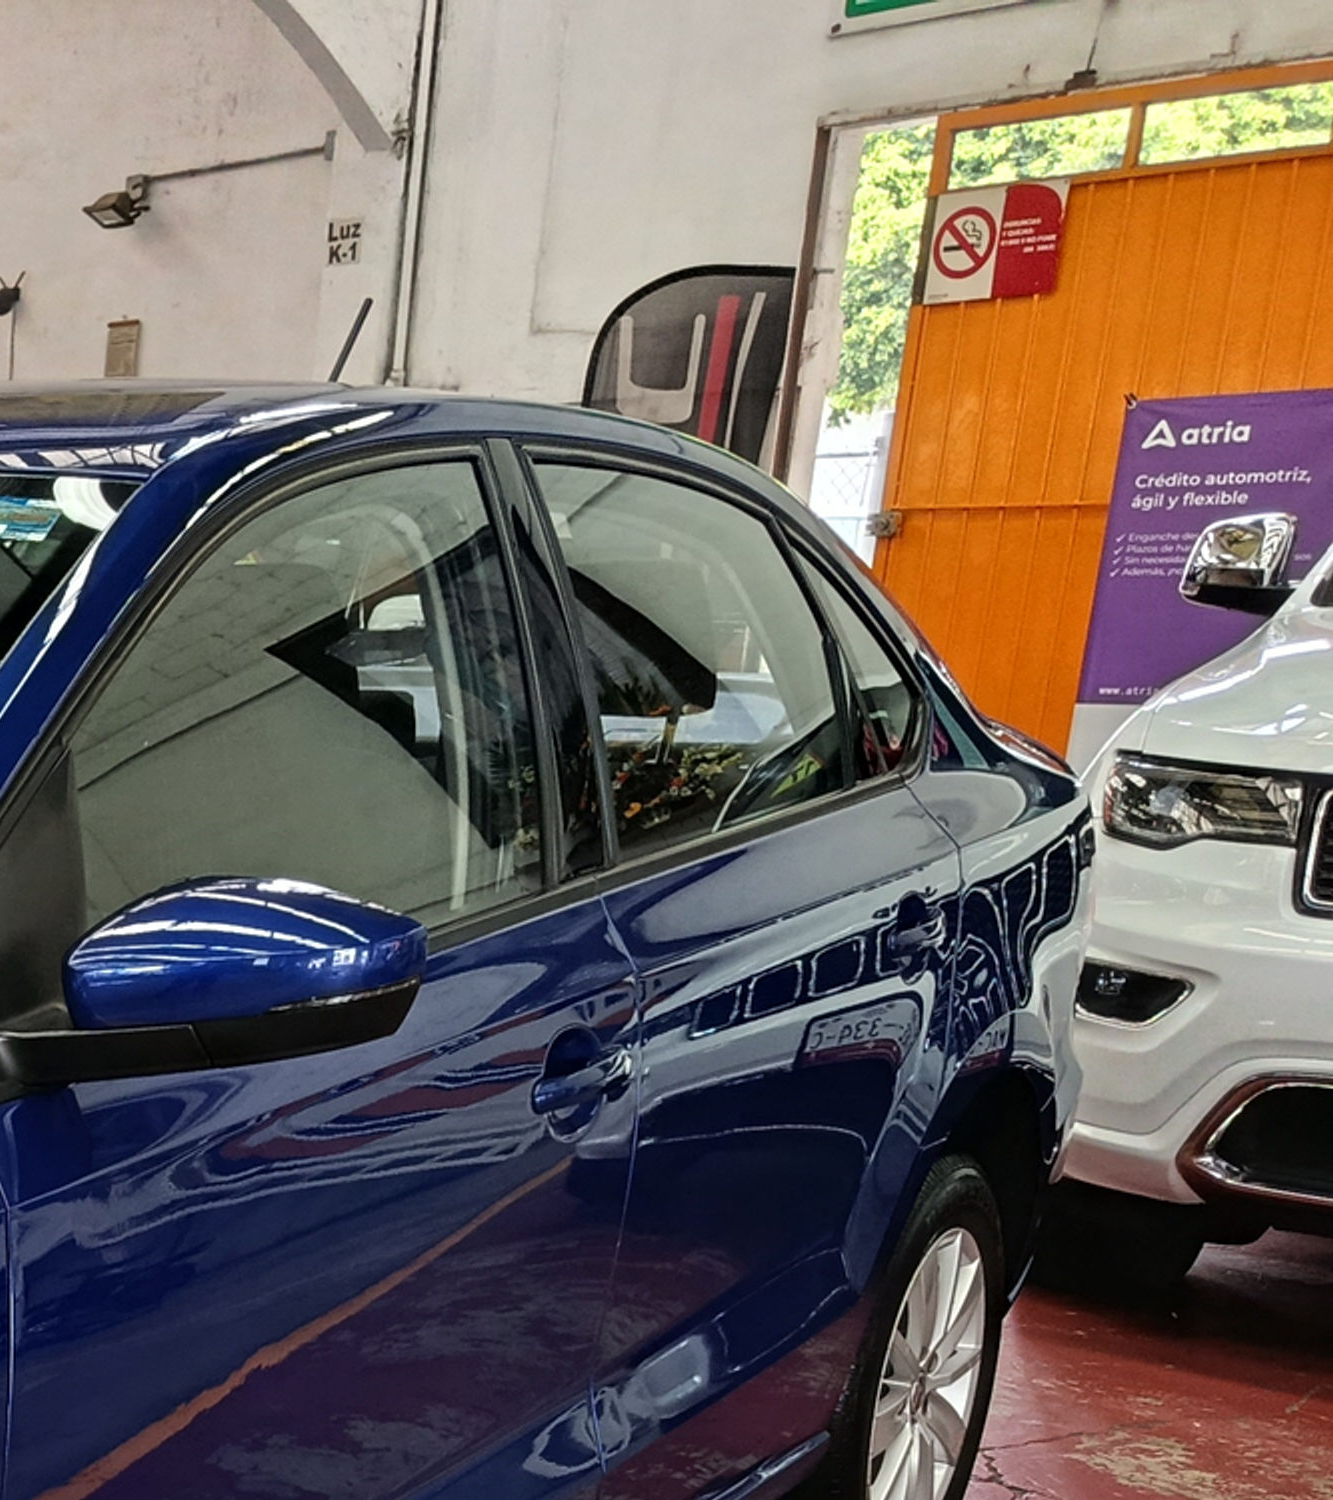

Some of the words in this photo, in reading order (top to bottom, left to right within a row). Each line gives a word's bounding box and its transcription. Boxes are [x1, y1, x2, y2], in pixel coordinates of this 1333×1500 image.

[328, 222, 362, 243] Luz
[329, 241, 357, 265] K-1
[1181, 420, 1252, 446] atria
[1135, 470, 1201, 490] Crédito
[1204, 466, 1312, 487] automotriz,
[1131, 493, 1165, 512] ágil
[1166, 494, 1179, 511] y
[1182, 490, 1249, 507] flexible
[1128, 532, 1180, 543] Enganche
[1124, 556, 1140, 565] Sin
[1141, 556, 1186, 564] necesida
